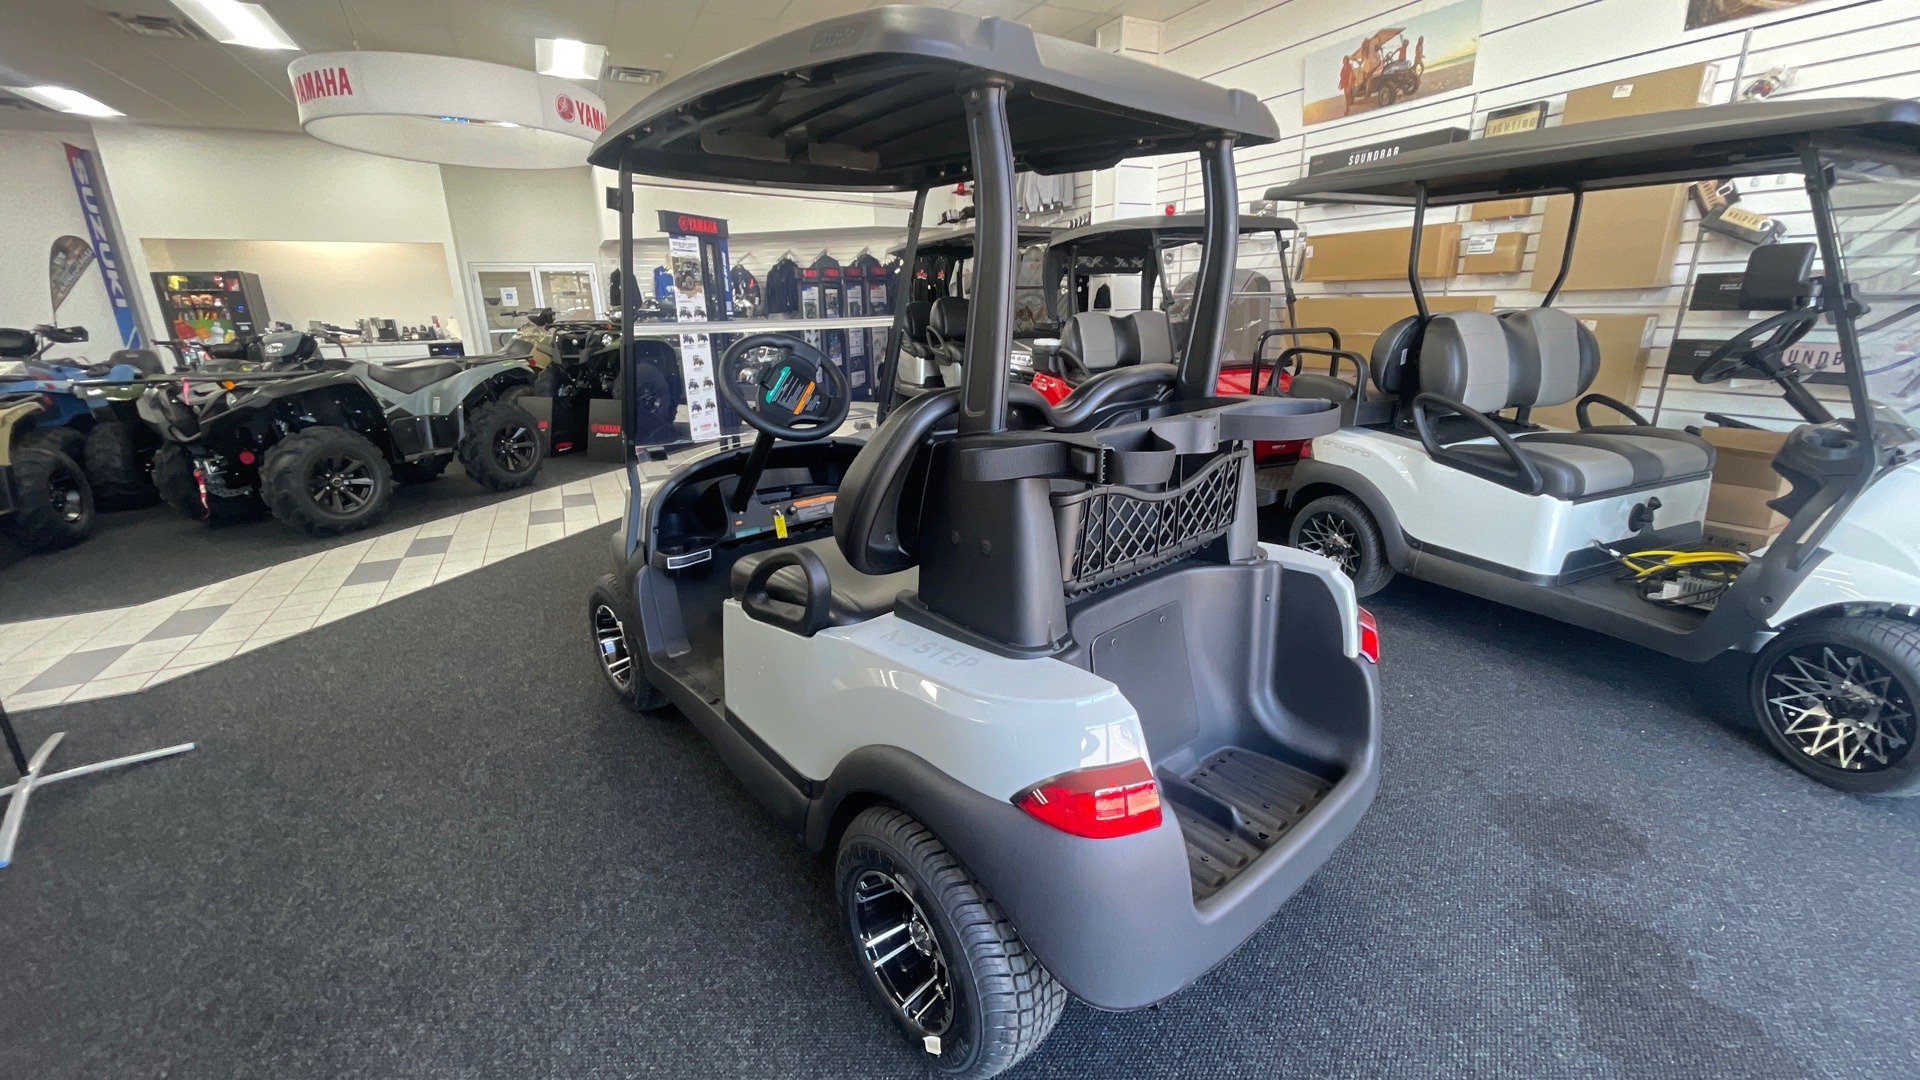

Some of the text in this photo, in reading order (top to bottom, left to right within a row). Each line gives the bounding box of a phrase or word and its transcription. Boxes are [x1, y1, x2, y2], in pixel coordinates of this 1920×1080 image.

[294, 67, 353, 105] YAMAHA
[1348, 146, 1399, 166] SOUNDBAR
[72, 156, 128, 308] SUZUKI
[688, 217, 718, 234] YAMAHA
[913, 641, 981, 668] STEP
